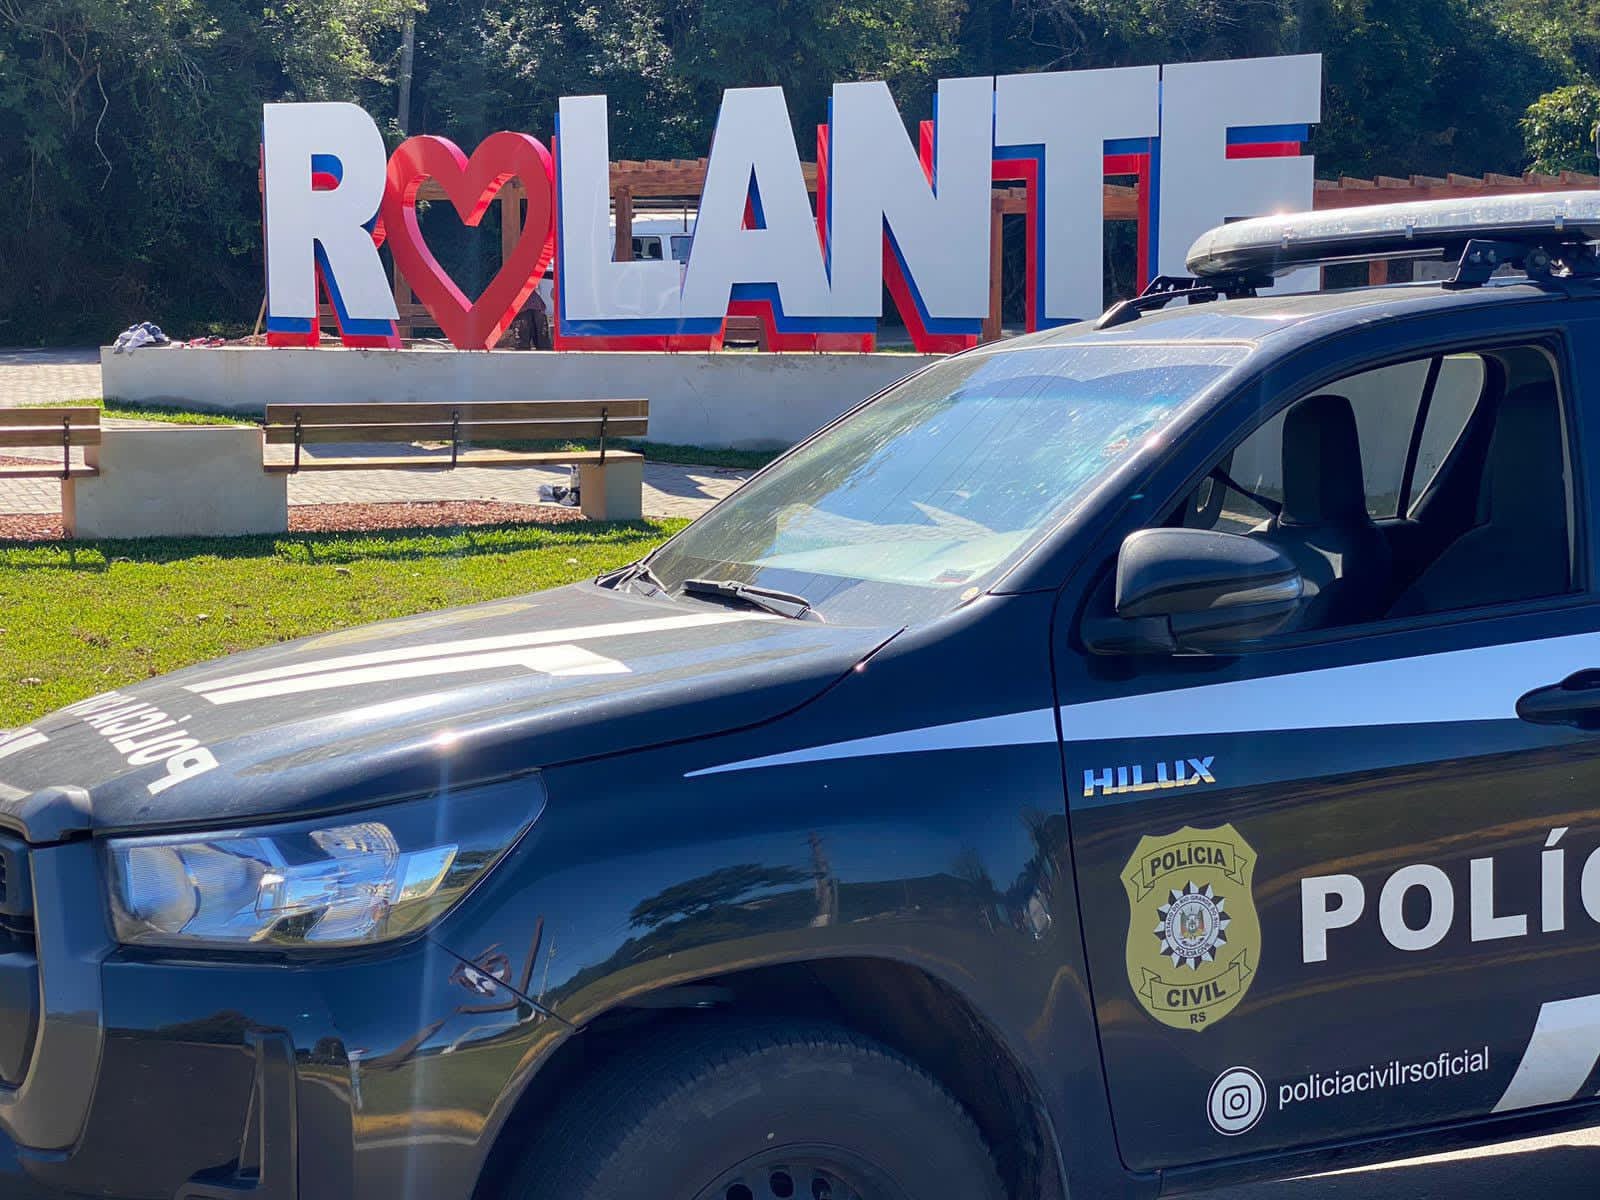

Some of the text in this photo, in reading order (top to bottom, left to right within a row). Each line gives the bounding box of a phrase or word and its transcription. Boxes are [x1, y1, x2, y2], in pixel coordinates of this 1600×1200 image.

[1083, 756, 1216, 797] HILUX
[1150, 844, 1227, 877] POLÍCIA
[1166, 981, 1226, 1007] CIVIL
[1190, 1012, 1206, 1024] RS
[1279, 1046, 1489, 1110] policiacivilrsoficial
